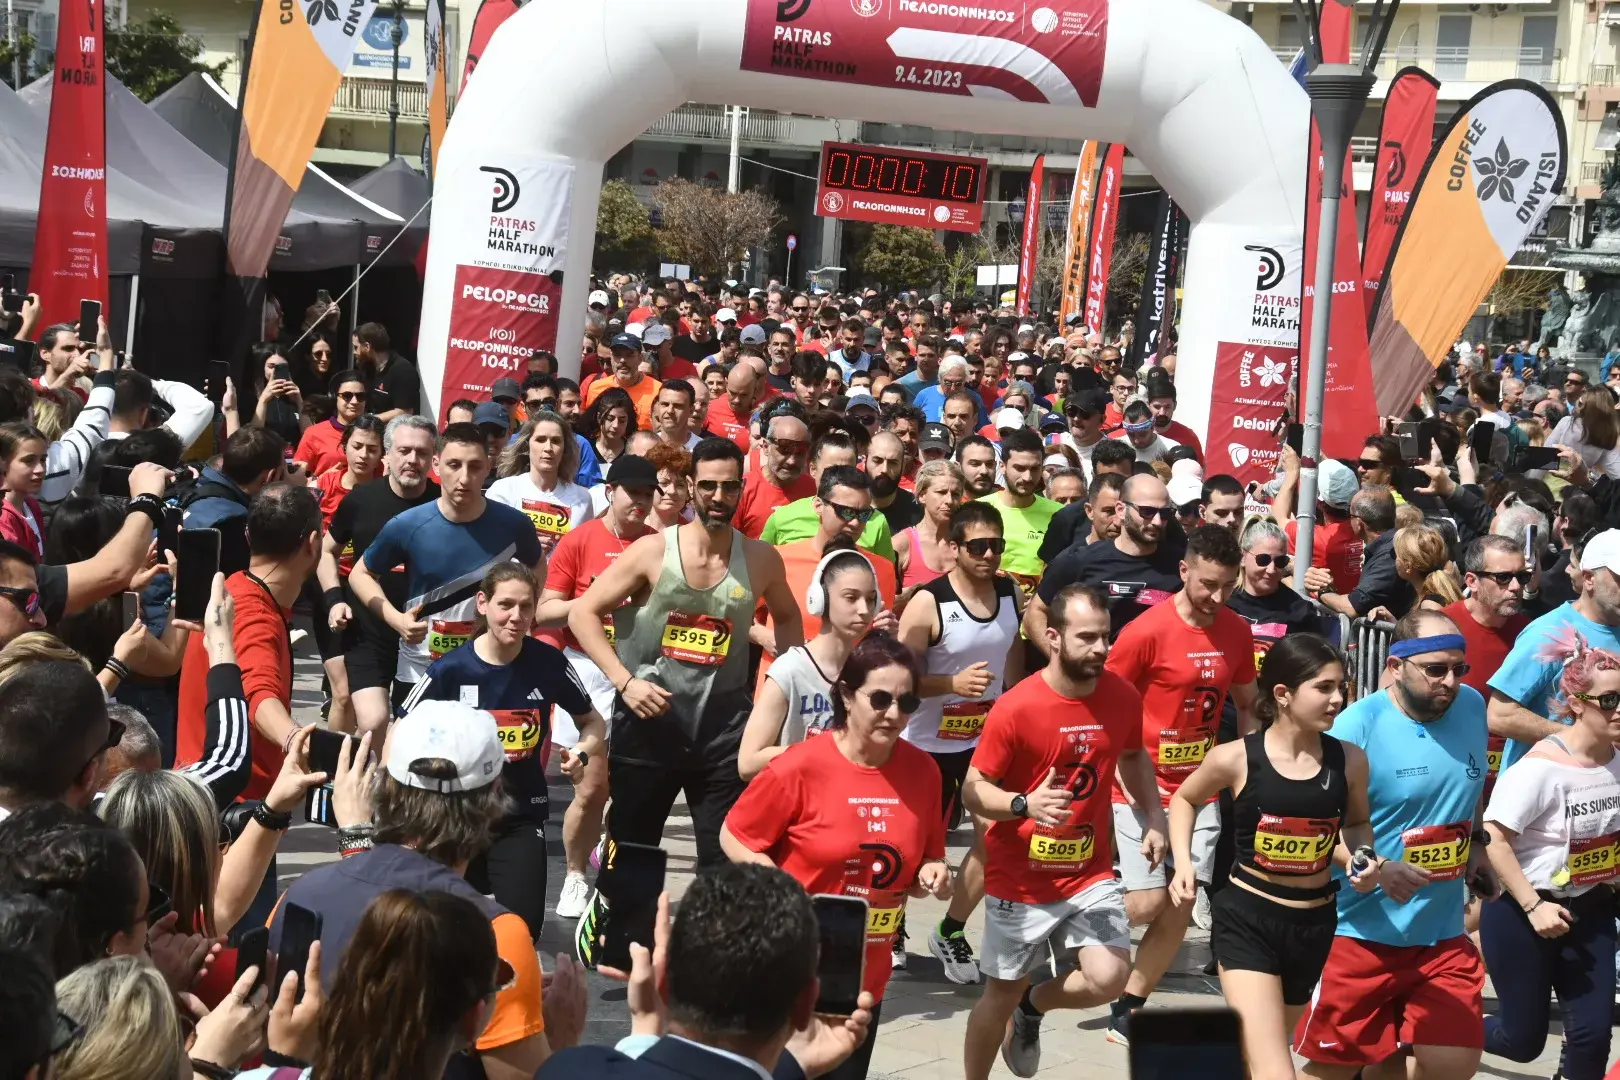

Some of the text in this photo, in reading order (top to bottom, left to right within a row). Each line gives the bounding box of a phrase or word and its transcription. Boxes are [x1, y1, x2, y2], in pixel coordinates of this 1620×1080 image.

[774, 25, 832, 46] PATRAS
[773, 41, 814, 57] HALF
[771, 54, 857, 75] MARATHON
[895, 64, 962, 88] 9.4.2023
[1447, 118, 1487, 192] COFFEE
[1516, 152, 1557, 224] ISLAND
[853, 200, 926, 216] ΠΕΛΟΠΟΝΝΗΣΟΣ
[490, 216, 536, 232] PATRAS
[489, 227, 521, 240] HALF
[487, 239, 555, 258] MARATHON
[1254, 294, 1299, 308] PATRAS
[1253, 304, 1286, 318] HALF
[450, 338, 534, 357] PELOPONNISOS
[481, 353, 520, 371] 104.1
[1240, 350, 1255, 388] COFFEE
[463, 383, 483, 391] EVENT
[669, 629, 707, 646] 5595
[945, 719, 979, 729] 5348
[1164, 744, 1200, 759] 5272
[531, 796, 548, 804] ERGO
[1037, 840, 1076, 855] 5505
[1262, 837, 1311, 854] 5407
[1409, 846, 1451, 864] 5523
[1573, 849, 1609, 869] 5559
[846, 885, 870, 895] PATRAS
[869, 913, 891, 927] 15
